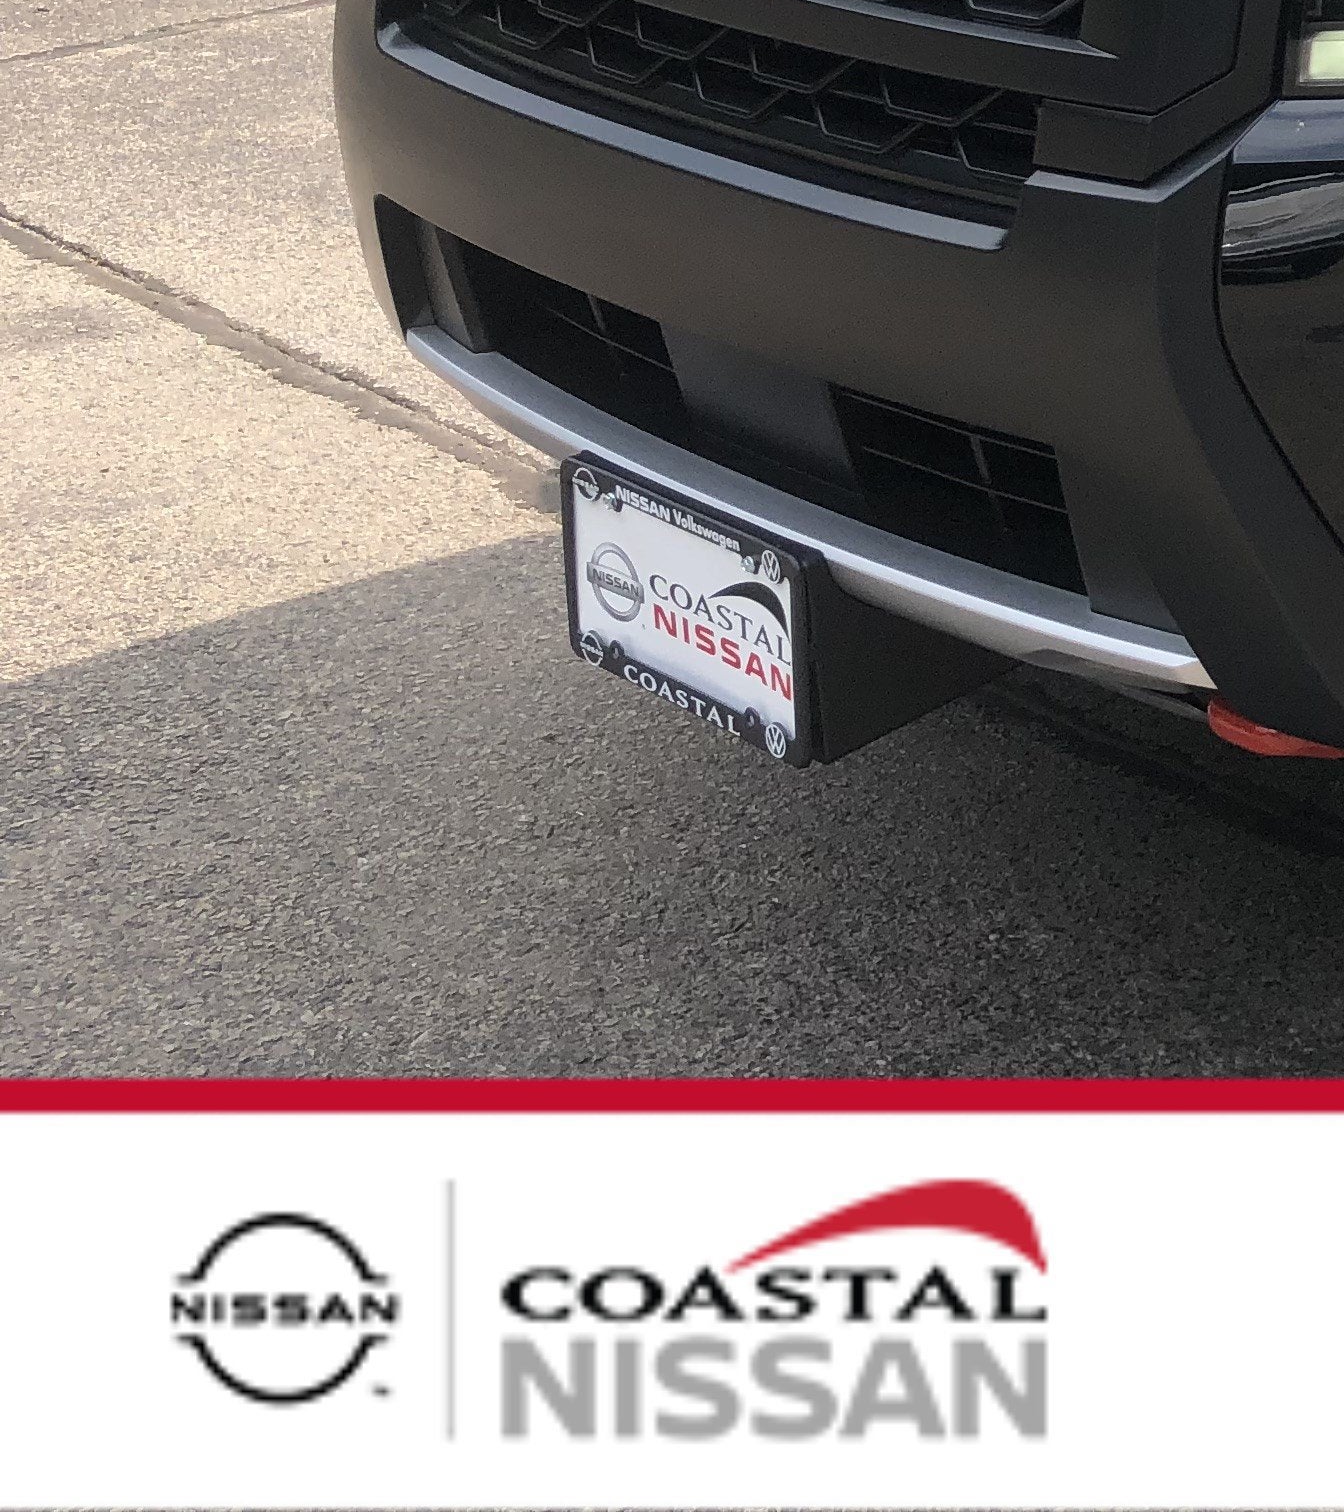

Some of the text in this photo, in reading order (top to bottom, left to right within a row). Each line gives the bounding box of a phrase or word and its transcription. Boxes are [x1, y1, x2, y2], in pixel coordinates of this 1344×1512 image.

[673, 508, 741, 553] Volkswagen
[591, 567, 640, 597] NISSAN
[649, 573, 791, 666] COASTAL
[652, 603, 793, 702] NISSAN
[624, 663, 741, 737] COASTAL
